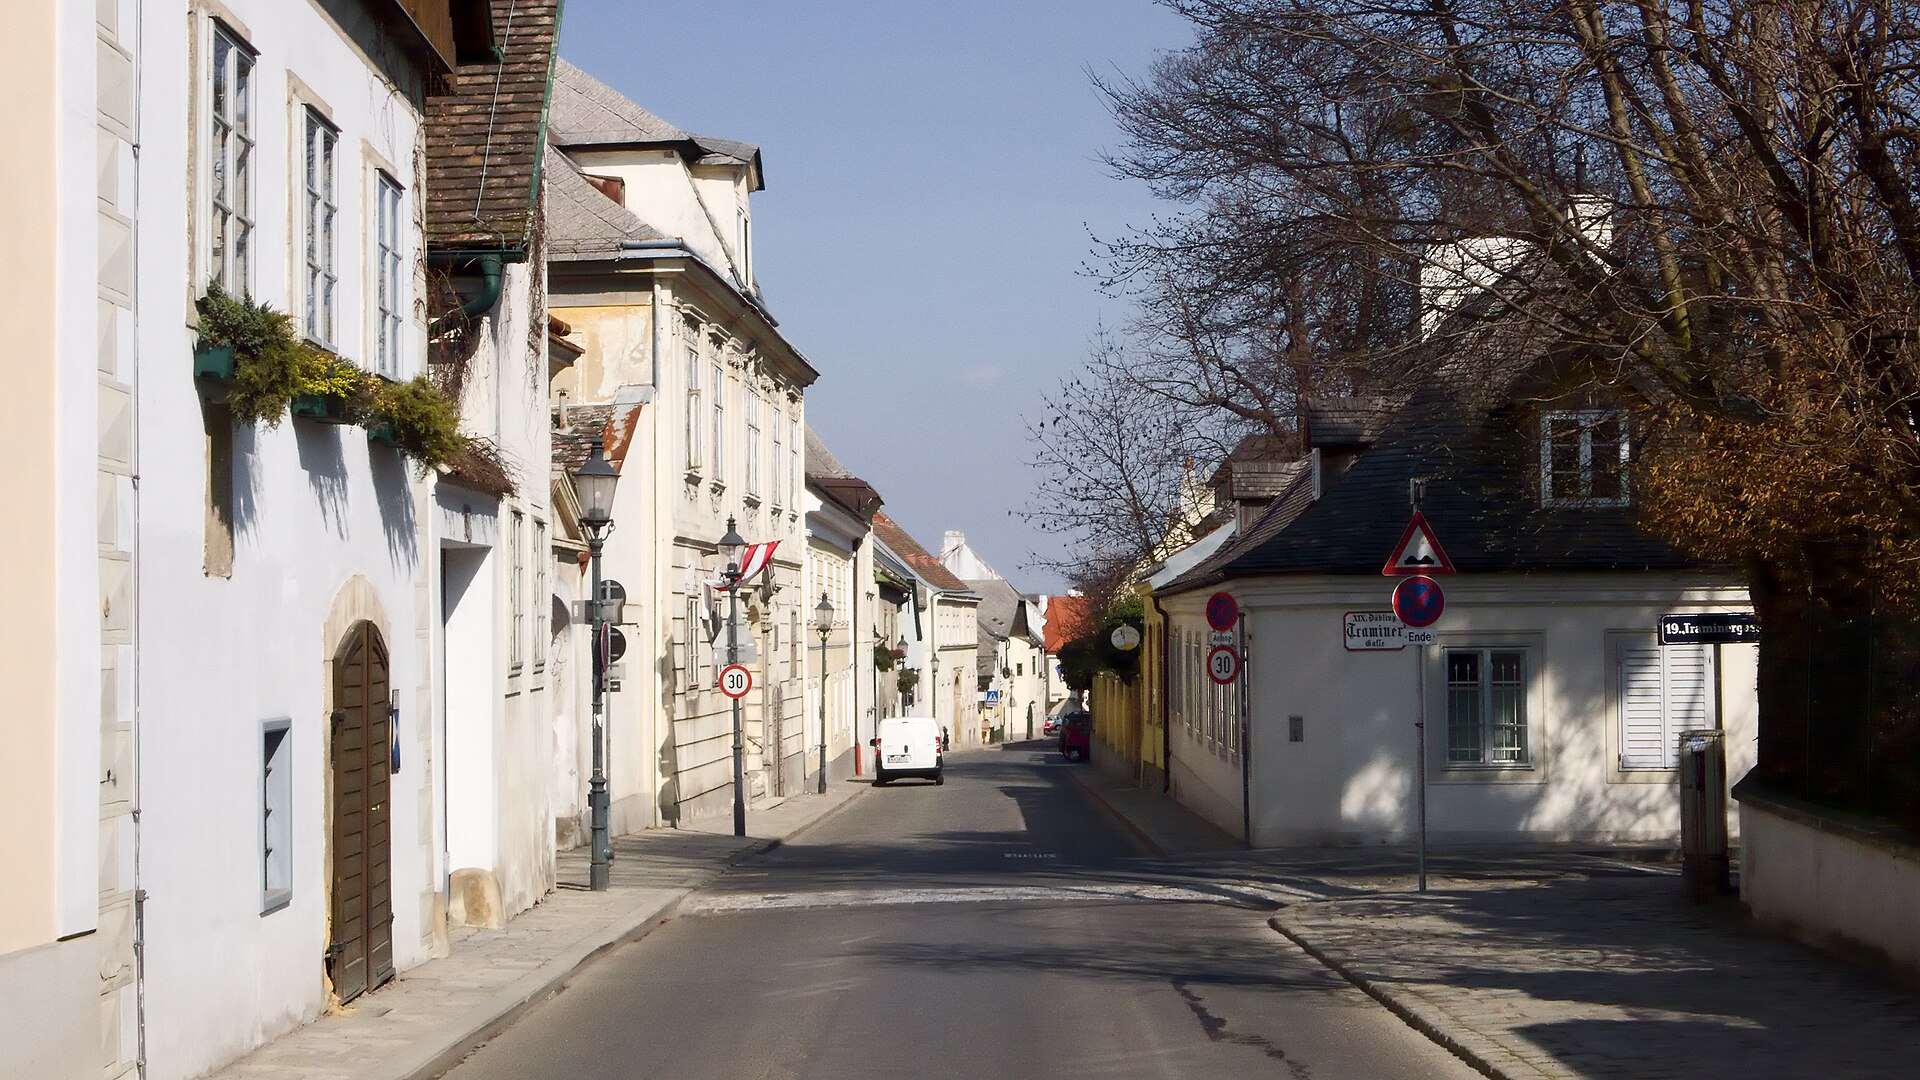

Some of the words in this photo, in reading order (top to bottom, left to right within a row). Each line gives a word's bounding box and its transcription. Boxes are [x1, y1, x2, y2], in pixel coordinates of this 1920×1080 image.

[1408, 632, 1432, 642] Ende
[1215, 656, 1230, 674] 30
[728, 674, 743, 689] 30
